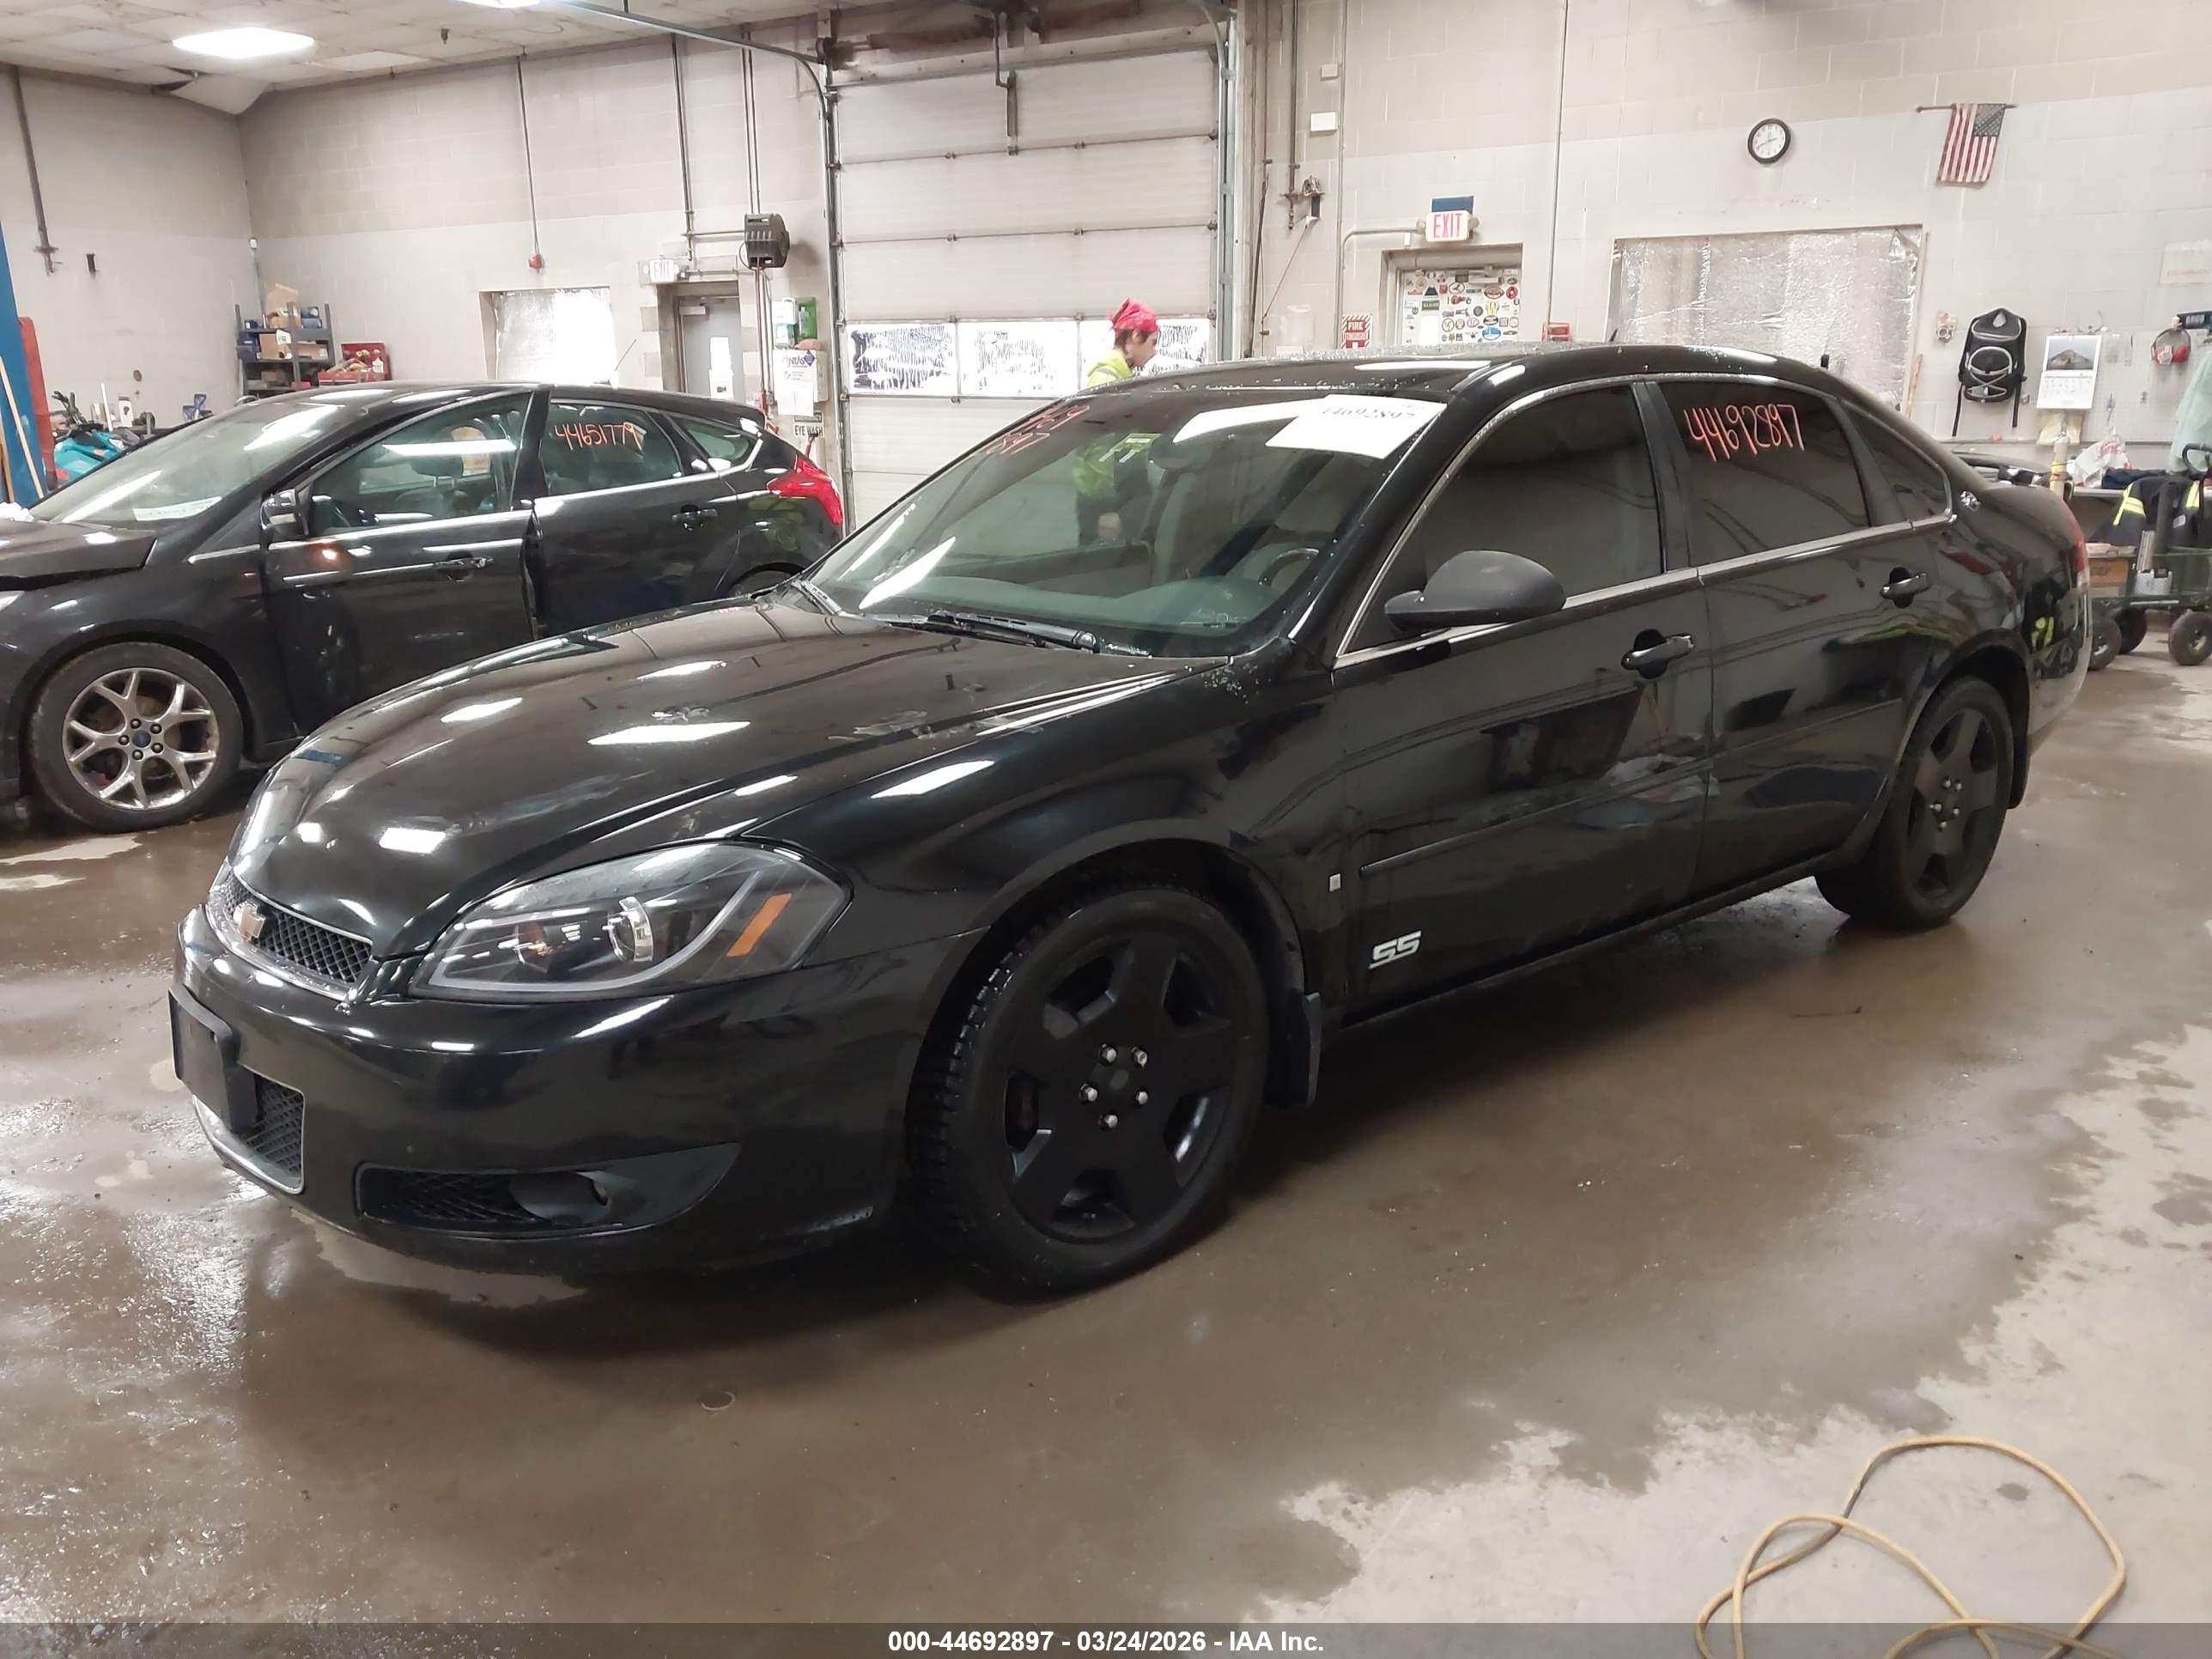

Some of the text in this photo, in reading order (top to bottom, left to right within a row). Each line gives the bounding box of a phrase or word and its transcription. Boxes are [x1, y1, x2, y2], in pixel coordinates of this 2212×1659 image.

[1433, 213, 1462, 239] EXIT
[1348, 321, 1364, 331] FIRE
[795, 425, 823, 437] EYE WASH
[1683, 404, 1805, 462] 44692897
[1369, 930, 1422, 969] SS
